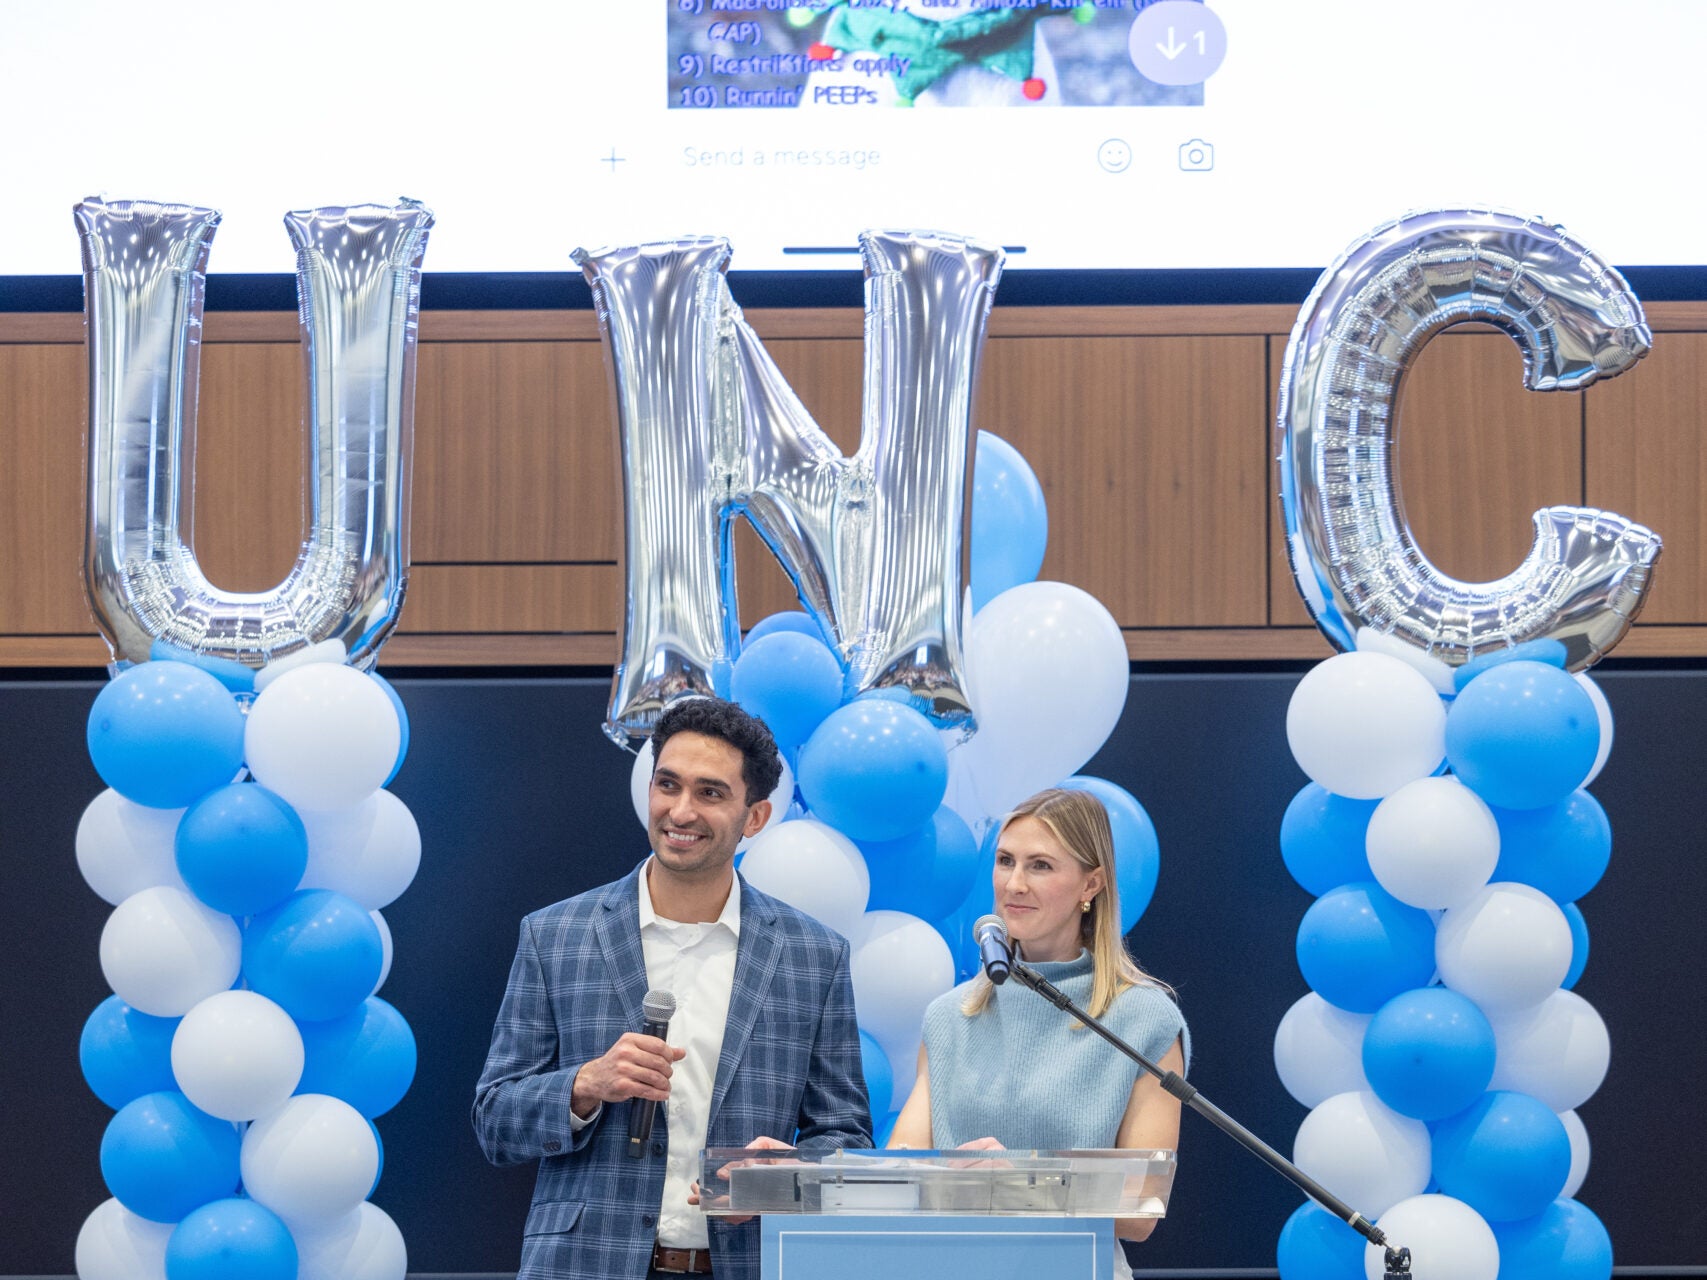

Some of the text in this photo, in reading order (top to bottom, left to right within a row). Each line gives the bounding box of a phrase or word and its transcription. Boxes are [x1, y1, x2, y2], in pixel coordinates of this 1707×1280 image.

[1192, 30, 1206, 56] 1
[678, 54, 704, 78] 9)
[853, 53, 911, 77] apply
[681, 85, 718, 108] 10)
[813, 86, 878, 104] PEEPs
[684, 146, 881, 170] Send a message
